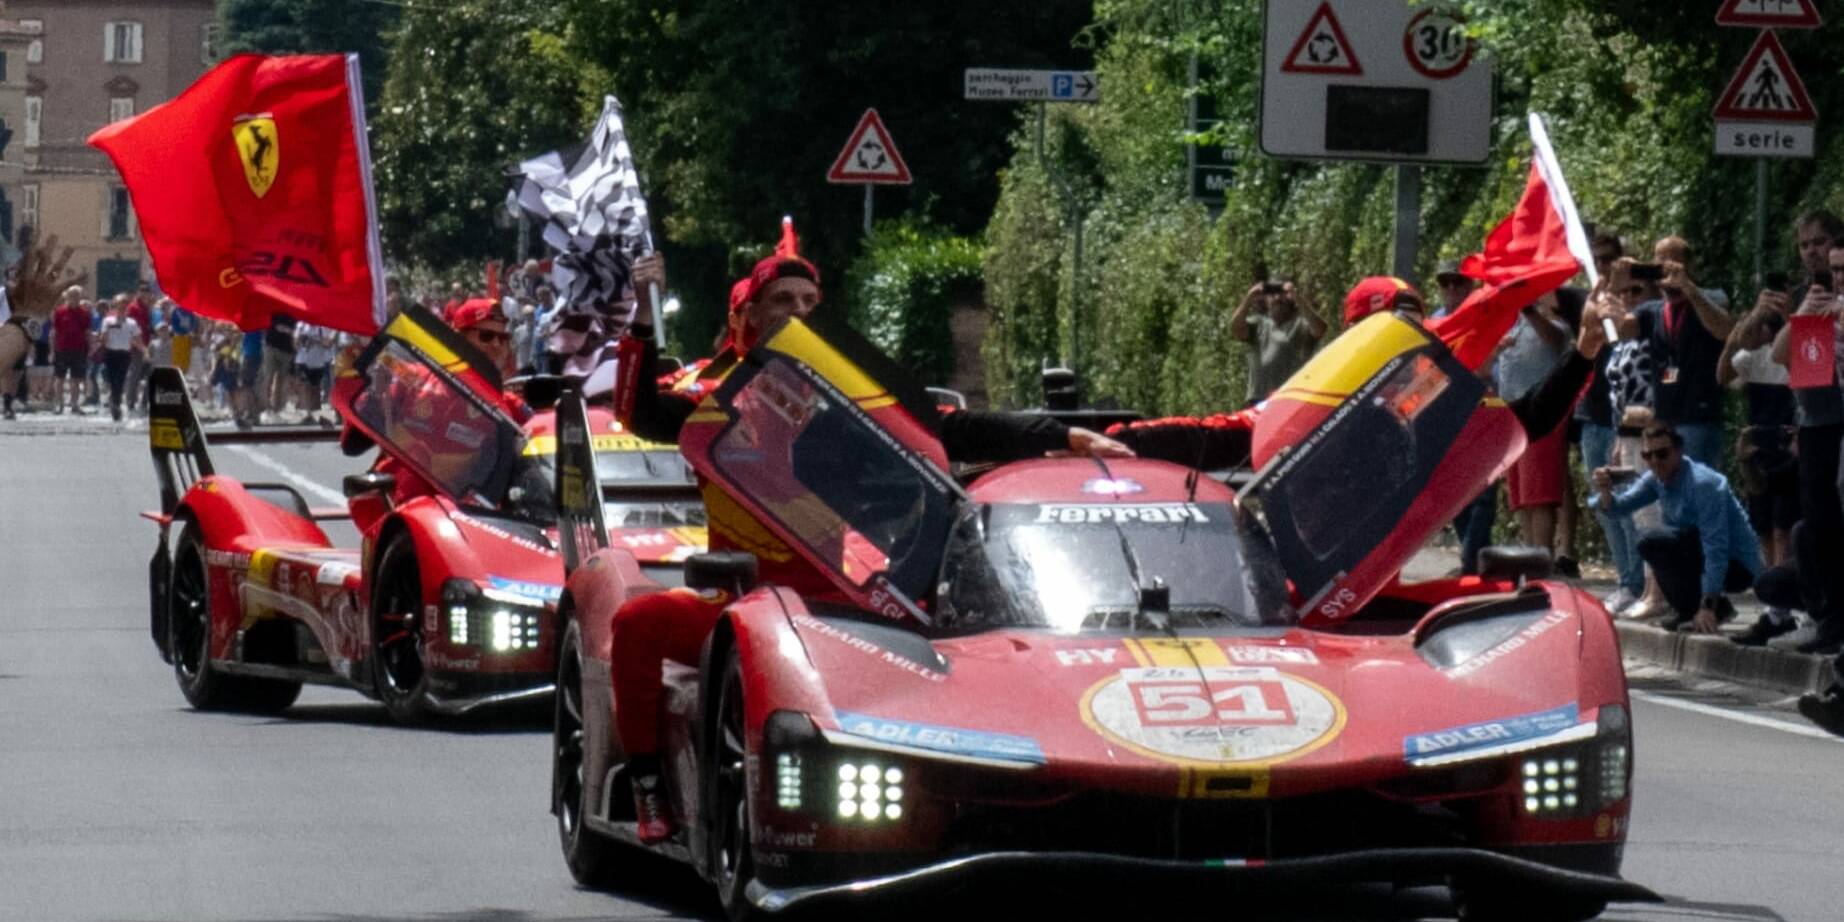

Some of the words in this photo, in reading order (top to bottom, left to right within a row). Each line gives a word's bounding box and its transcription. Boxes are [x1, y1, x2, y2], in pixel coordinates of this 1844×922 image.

[1419, 25, 1461, 60] 30
[1010, 86, 1049, 97] Ferrari
[1733, 130, 1795, 149] serie
[1033, 502, 1210, 524] Ferrari
[791, 614, 879, 655] RICHARD
[882, 651, 947, 683] MILLE
[1054, 648, 1117, 666] HY
[1137, 685, 1289, 721] 51
[853, 720, 959, 746] ADLER
[1415, 722, 1513, 754] ADLER
